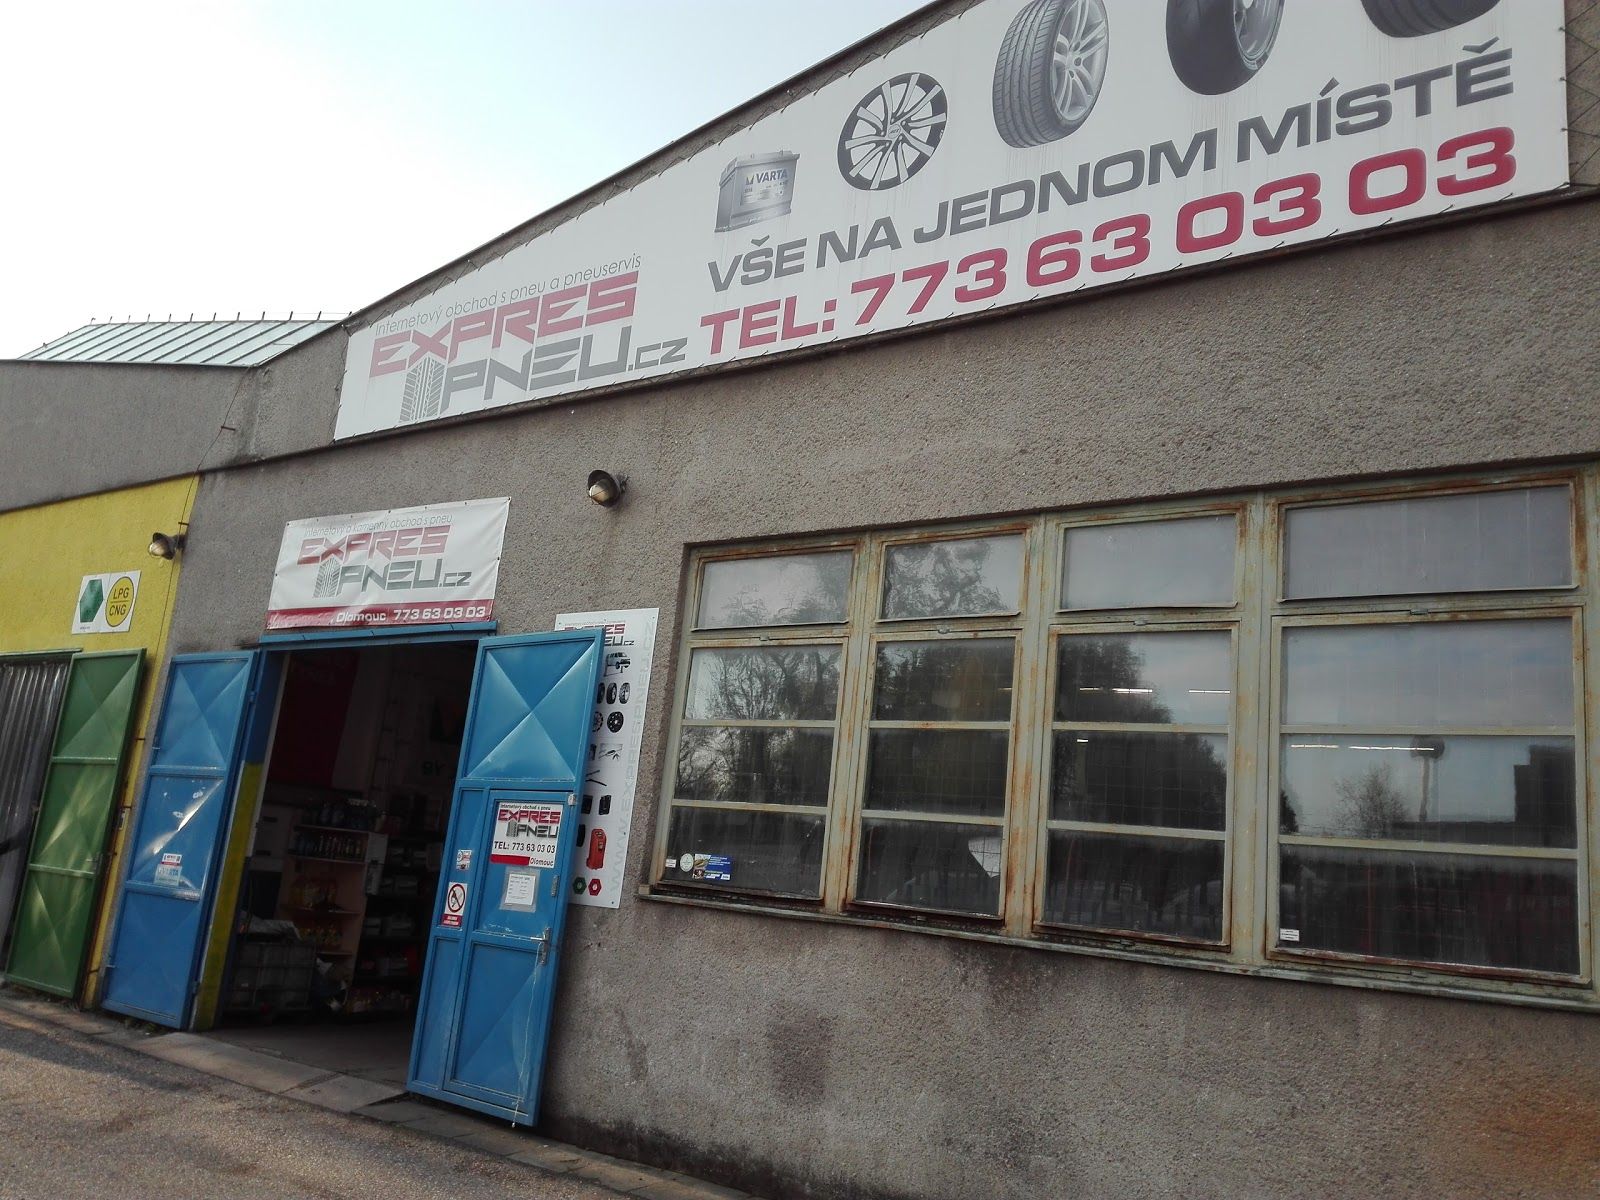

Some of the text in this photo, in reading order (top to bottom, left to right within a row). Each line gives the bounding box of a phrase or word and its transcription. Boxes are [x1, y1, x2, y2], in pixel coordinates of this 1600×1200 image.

[708, 36, 1514, 292] VŠE NA JEDNOM MÍSTĚ
[756, 168, 788, 183] VARTA
[700, 126, 1516, 354] TEL: 773 63 03 03
[375, 253, 641, 336] Internetový obchod s pneu a pneuservis
[370, 271, 639, 378] EXPRES
[390, 516, 422, 528] obchod
[430, 514, 452, 526] pneu
[297, 525, 450, 564] EXPRES
[113, 588, 130, 600] LPG
[109, 604, 126, 616] CNG
[336, 606, 486, 624] Olomouc 773 63 03 03
[498, 809, 561, 824] EXPRES
[516, 824, 559, 838] PNEU
[494, 841, 556, 854] TEL: 773 63 03 03
[530, 858, 554, 867] Olomouc
